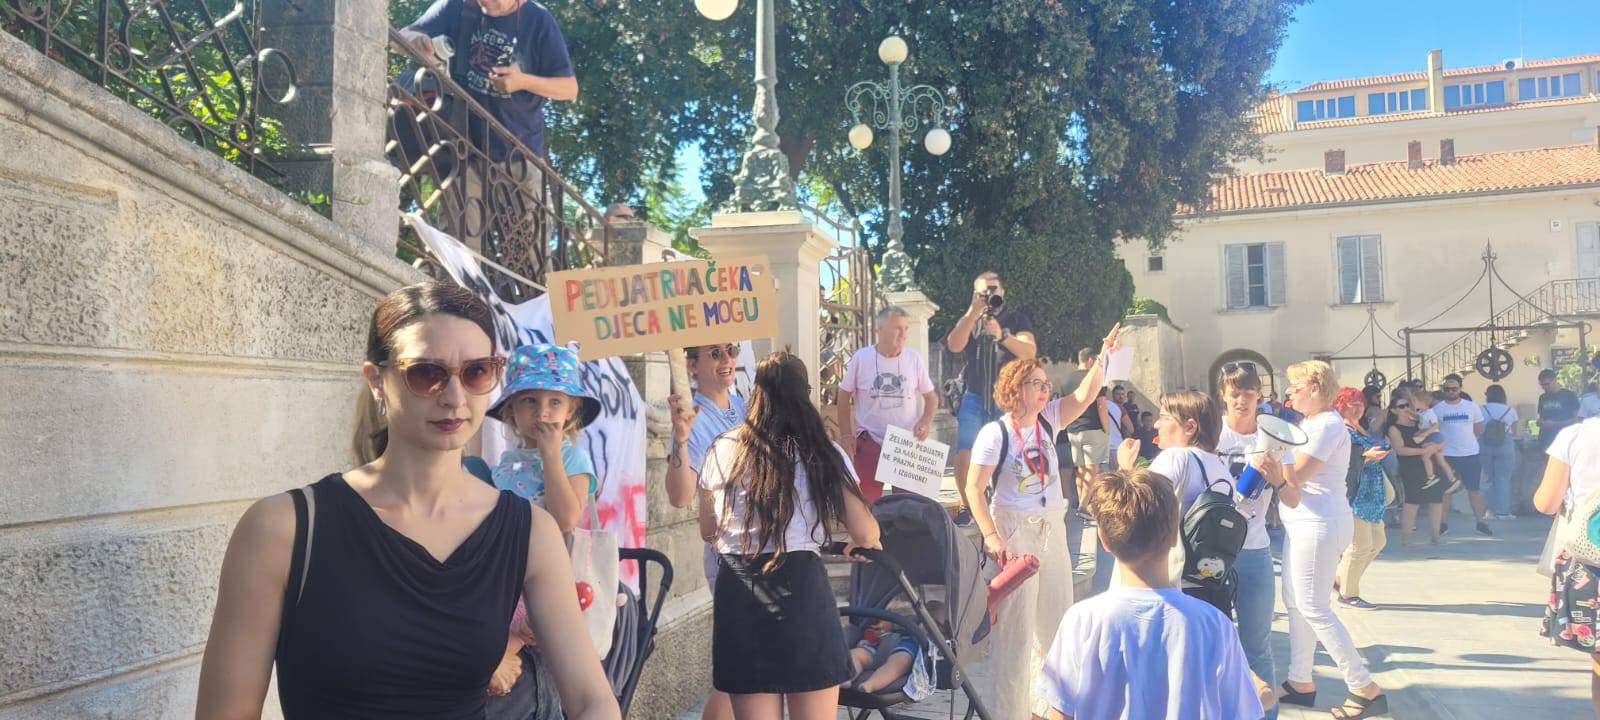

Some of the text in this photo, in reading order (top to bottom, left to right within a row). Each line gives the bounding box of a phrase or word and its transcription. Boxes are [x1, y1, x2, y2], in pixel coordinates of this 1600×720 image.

[706, 261, 753, 292] ČEKA
[594, 296, 759, 340] DJECA NE MOGU
